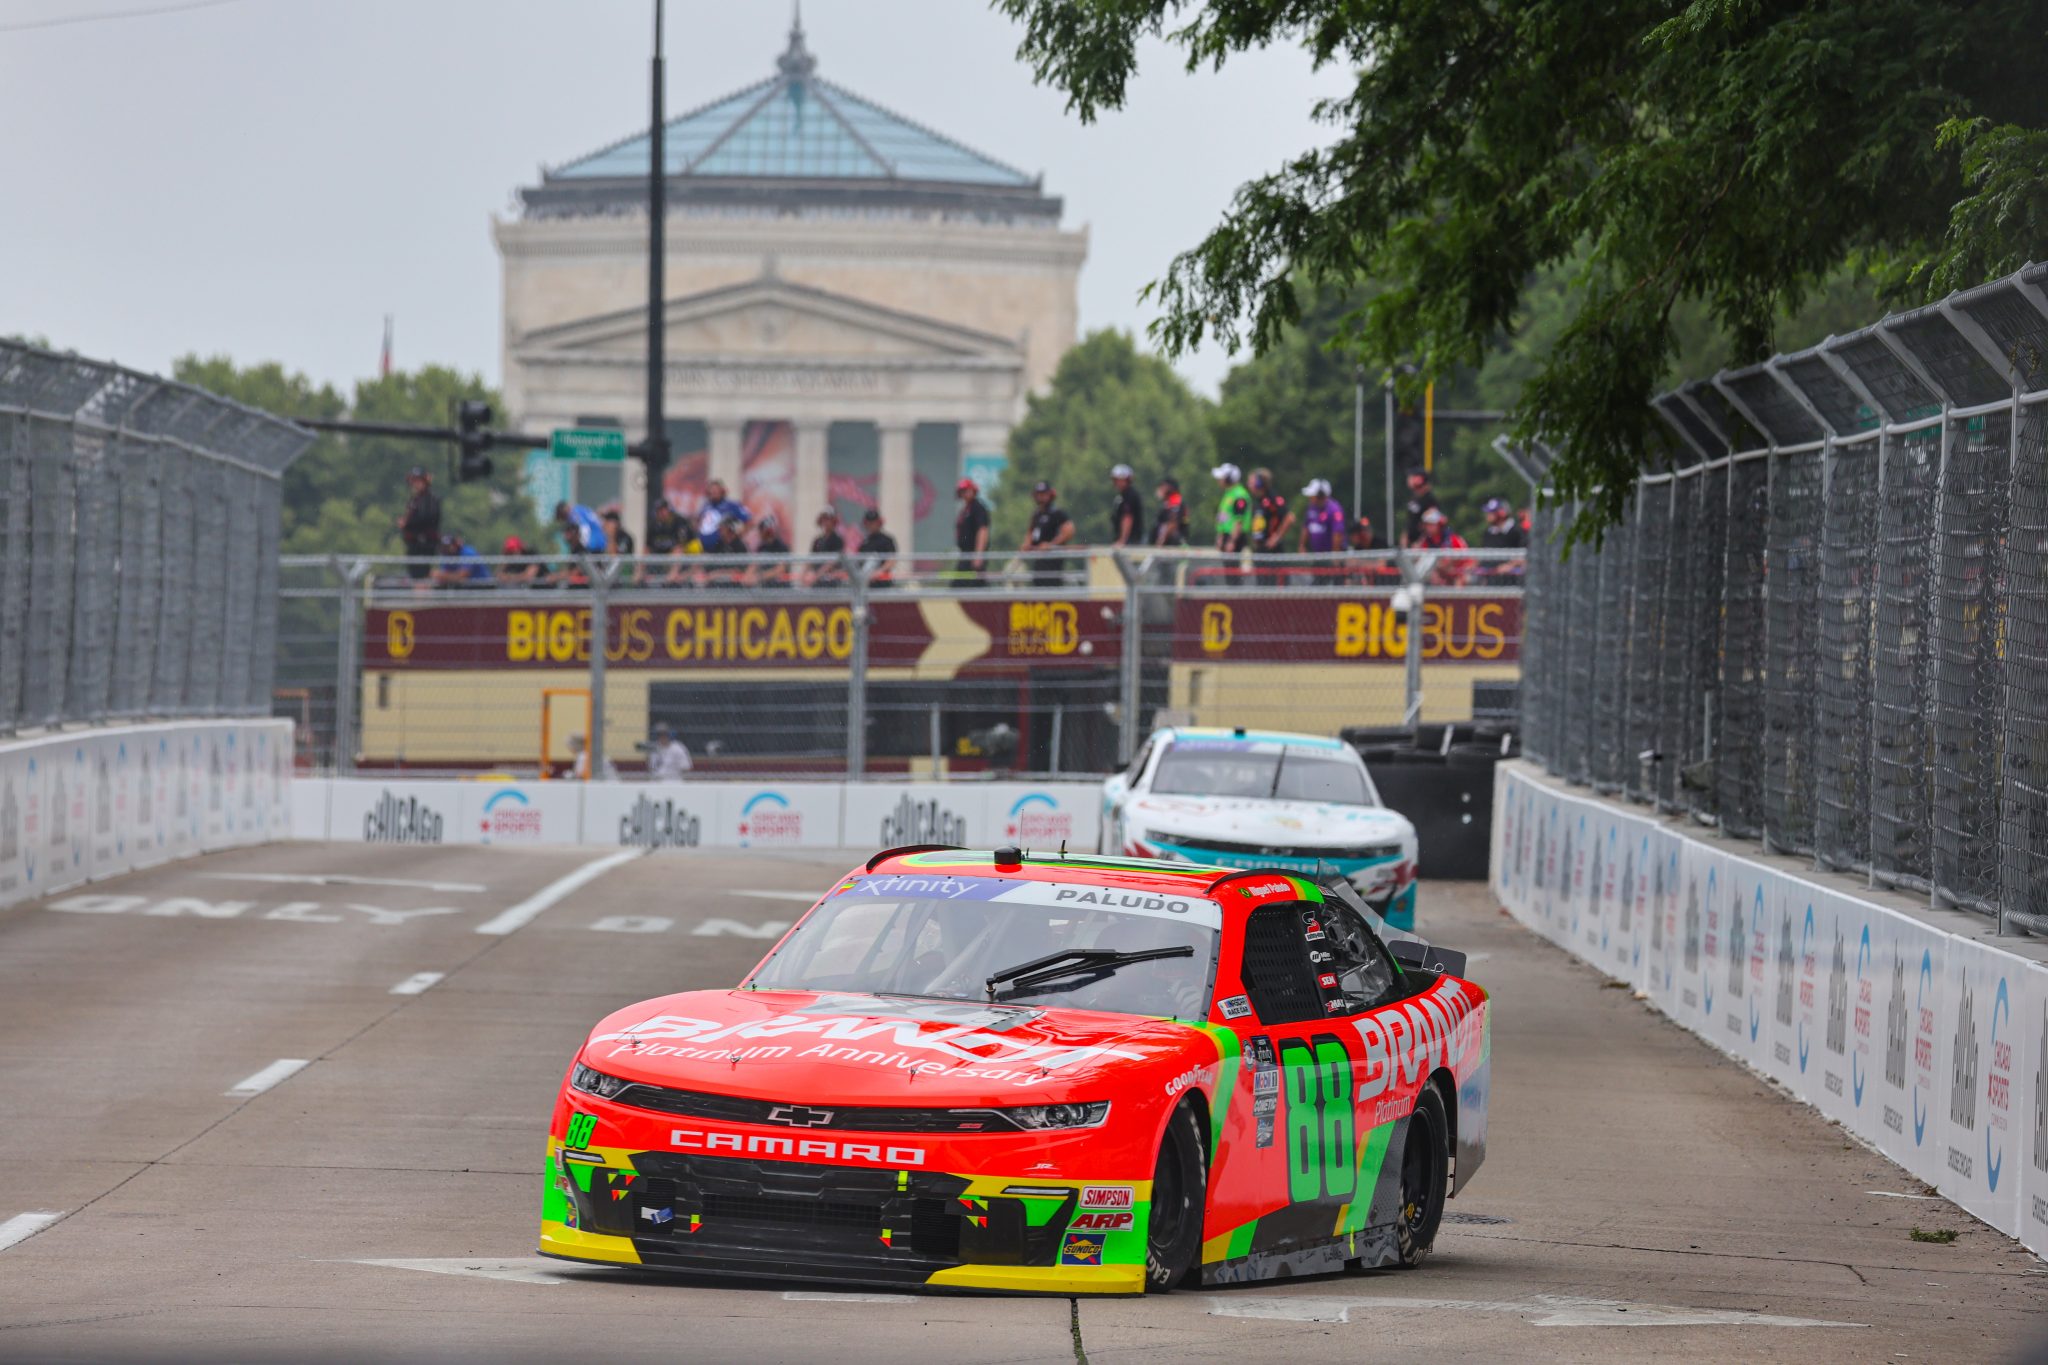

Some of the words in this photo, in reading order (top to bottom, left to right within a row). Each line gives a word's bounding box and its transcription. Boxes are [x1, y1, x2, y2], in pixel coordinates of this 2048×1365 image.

[665, 607, 854, 660] CHICAGO
[858, 875, 980, 899] xfinity
[1248, 884, 1272, 897] Miguel
[1269, 882, 1291, 893] Paludo
[47, 895, 463, 924] ONLY
[1055, 889, 1190, 914] PALUDO
[1321, 975, 1336, 985] SEM
[587, 1014, 1148, 1069] BRANDT
[607, 1042, 792, 1061] Platinum
[799, 1043, 1054, 1086] Anniversary
[1256, 1072, 1271, 1089] Mobil
[1280, 1037, 1357, 1204] 88
[1374, 1095, 1411, 1125] Platinum
[565, 1112, 598, 1149] 88
[670, 1129, 926, 1166] CAMARO
[1084, 1188, 1131, 1206] SIMPSON
[1070, 1212, 1133, 1229] ARP
[1064, 1245, 1102, 1255] SUNOCO
